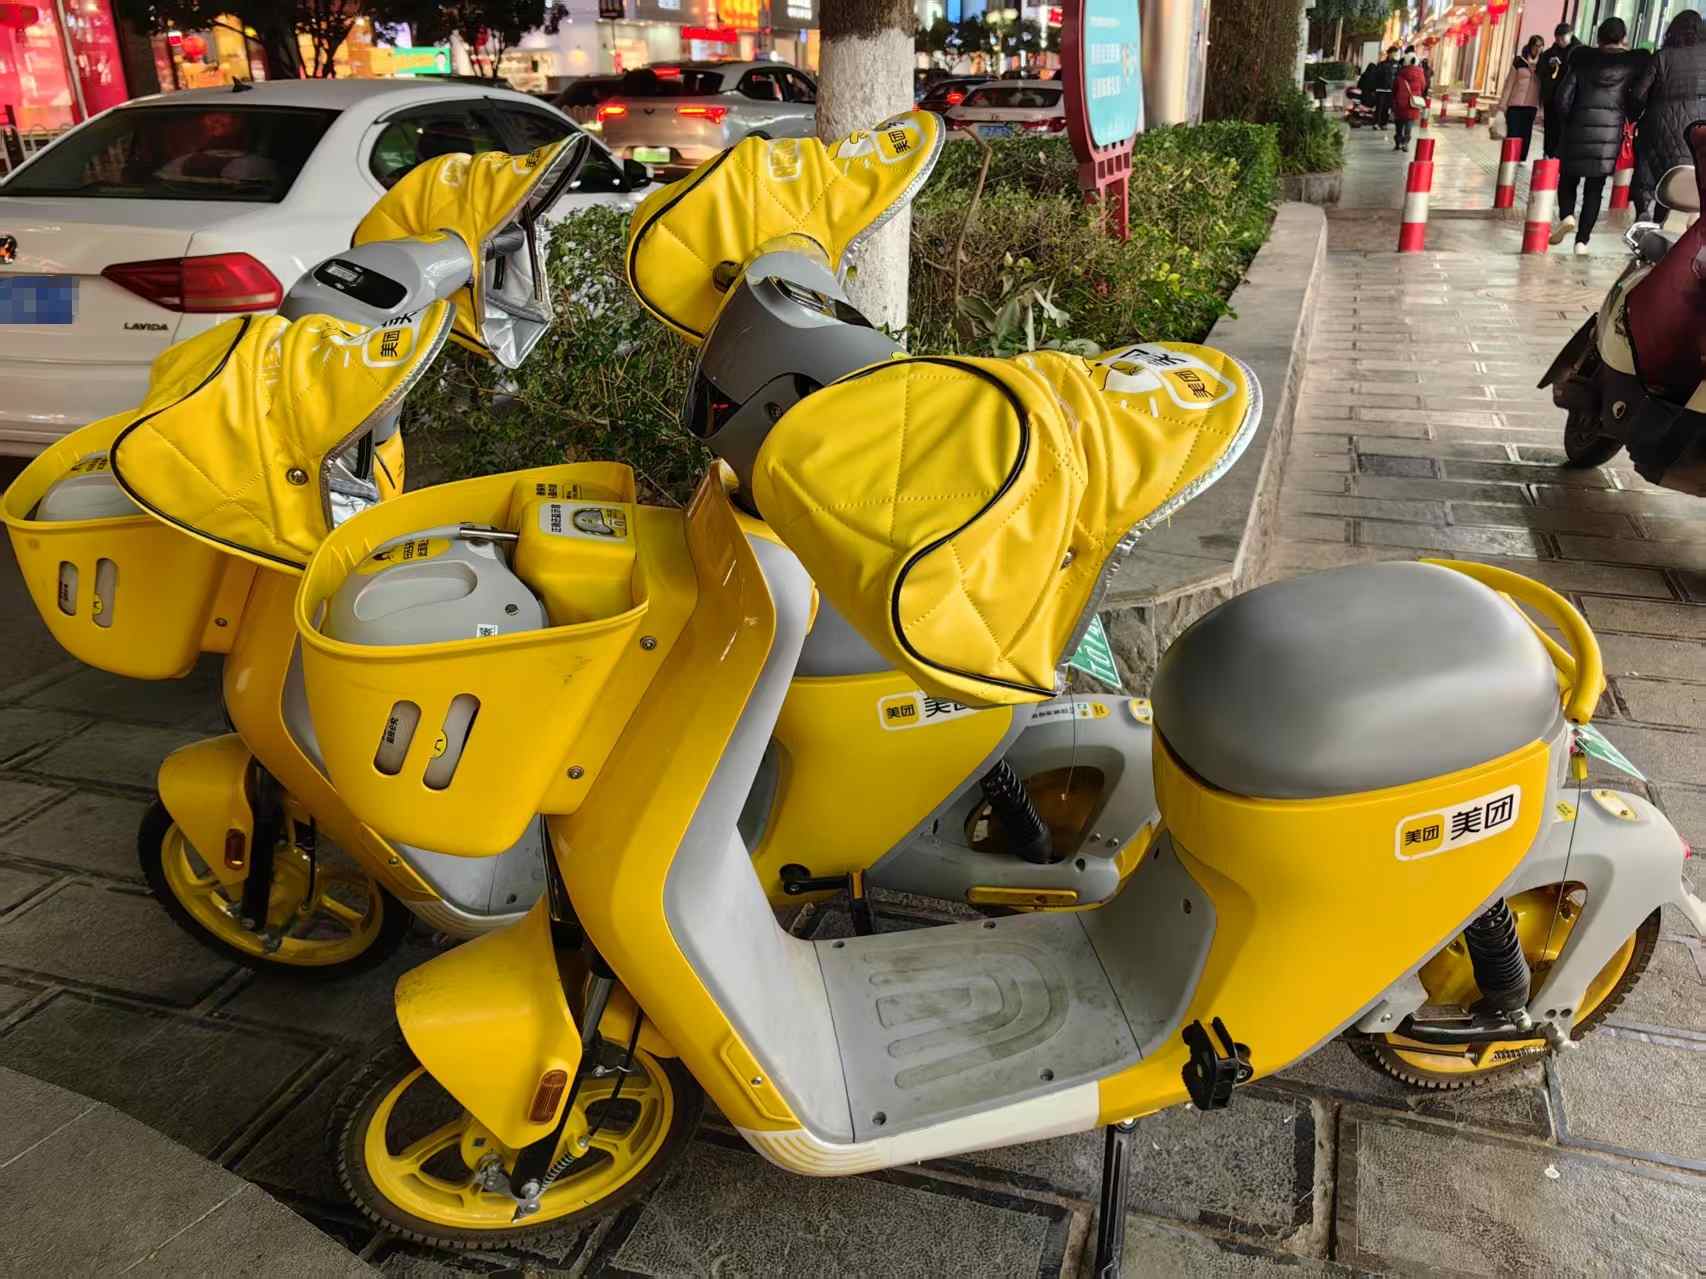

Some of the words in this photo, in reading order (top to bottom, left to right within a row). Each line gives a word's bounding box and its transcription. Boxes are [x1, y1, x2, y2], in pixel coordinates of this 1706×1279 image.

[888, 130, 911, 154] 美团
[124, 322, 168, 331] LAVIDA
[381, 330, 400, 357] 美团
[1173, 370, 1215, 401] 美团
[887, 704, 915, 719] 美团
[1405, 825, 1439, 846] 美团
[1451, 793, 1514, 840] 美团
